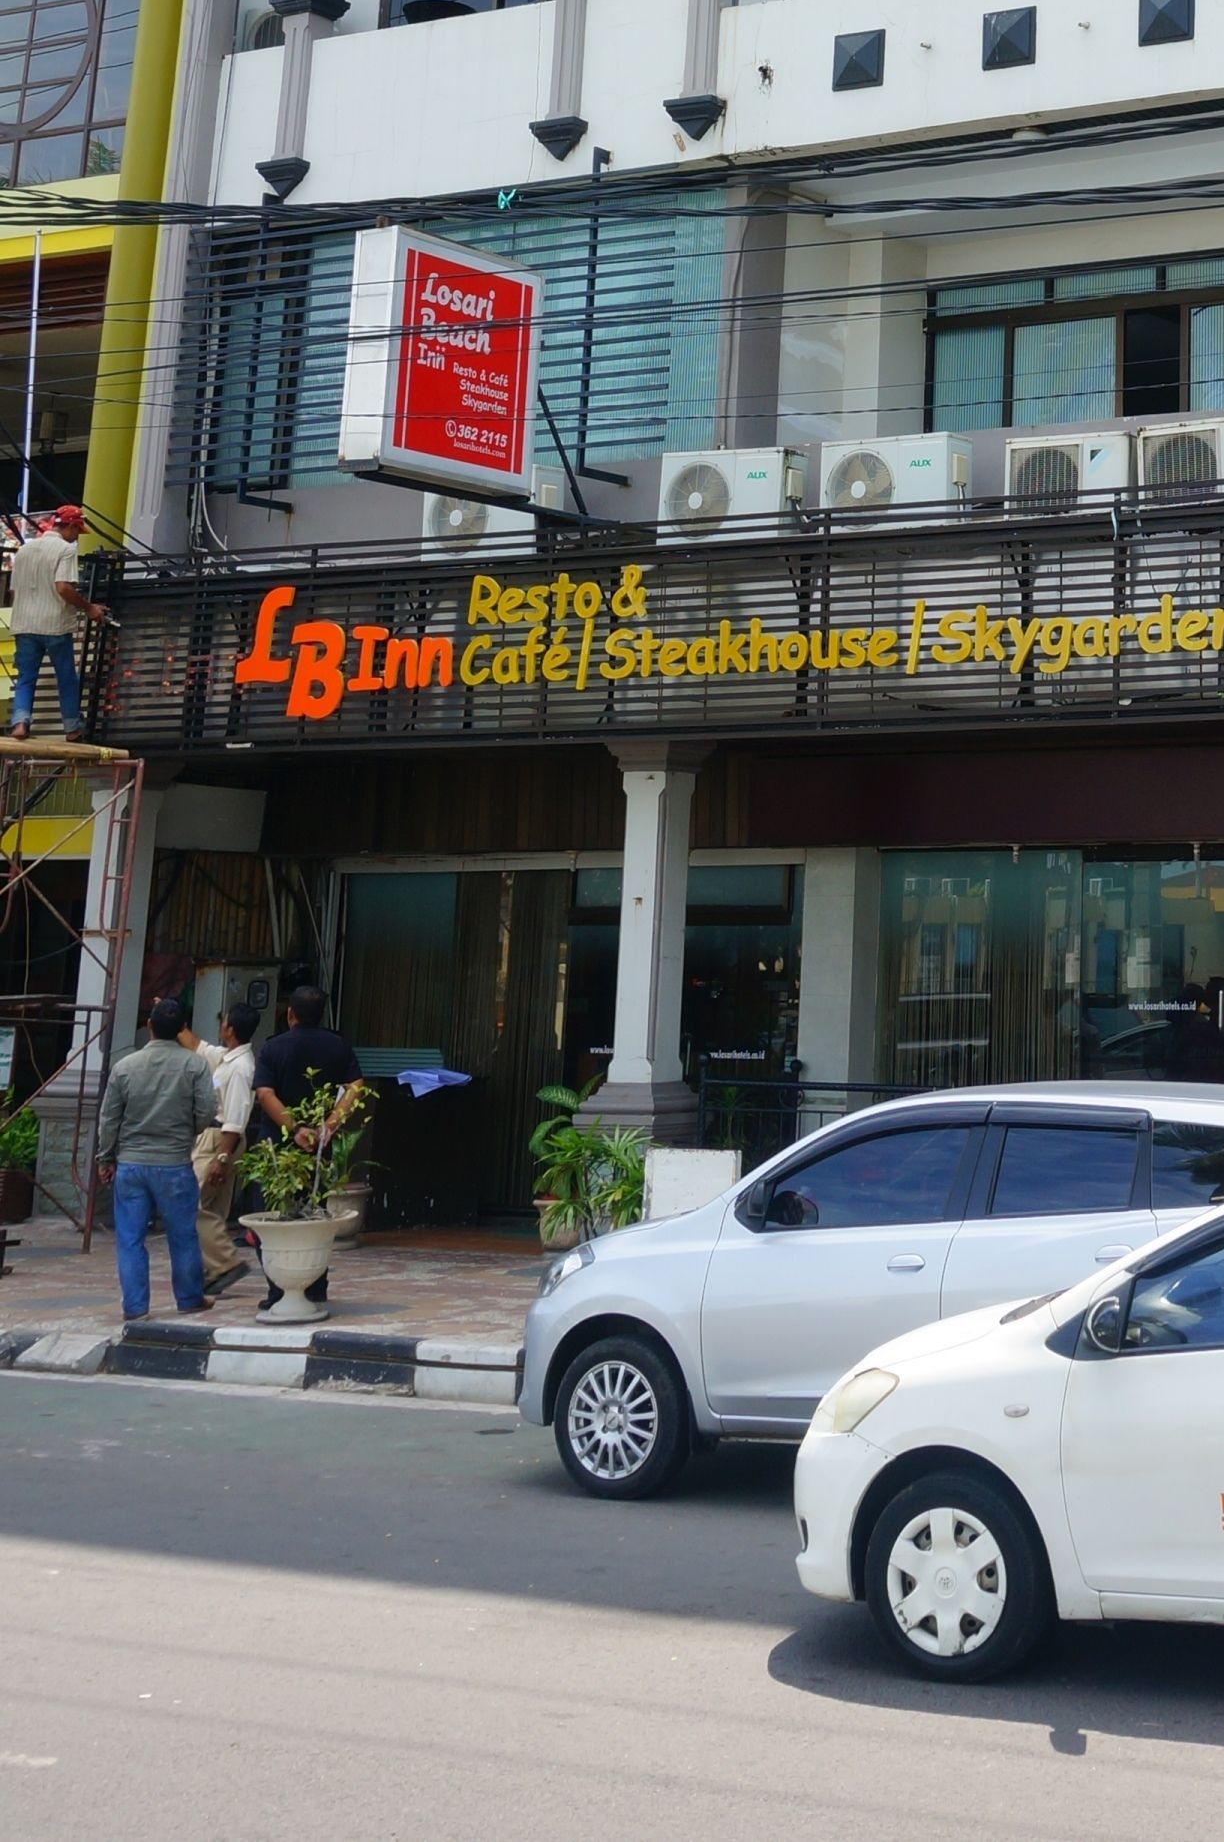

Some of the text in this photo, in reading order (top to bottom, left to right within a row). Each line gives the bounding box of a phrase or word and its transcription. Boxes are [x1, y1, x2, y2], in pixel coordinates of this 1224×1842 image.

[420, 272, 495, 322] Losari
[420, 307, 491, 355] Beach
[453, 361, 509, 387] Resto & Café
[459, 378, 509, 401] Steakhouse
[461, 393, 508, 416] Skygarden
[457, 424, 508, 448] 362 2115
[453, 438, 506, 459] losarihotels.com
[746, 471, 768, 479] AUX
[910, 459, 932, 468] AUX
[468, 564, 647, 626] Resto &
[347, 626, 454, 691] Inn
[1128, 1000, 1197, 1011] www.losarihotels.co.id
